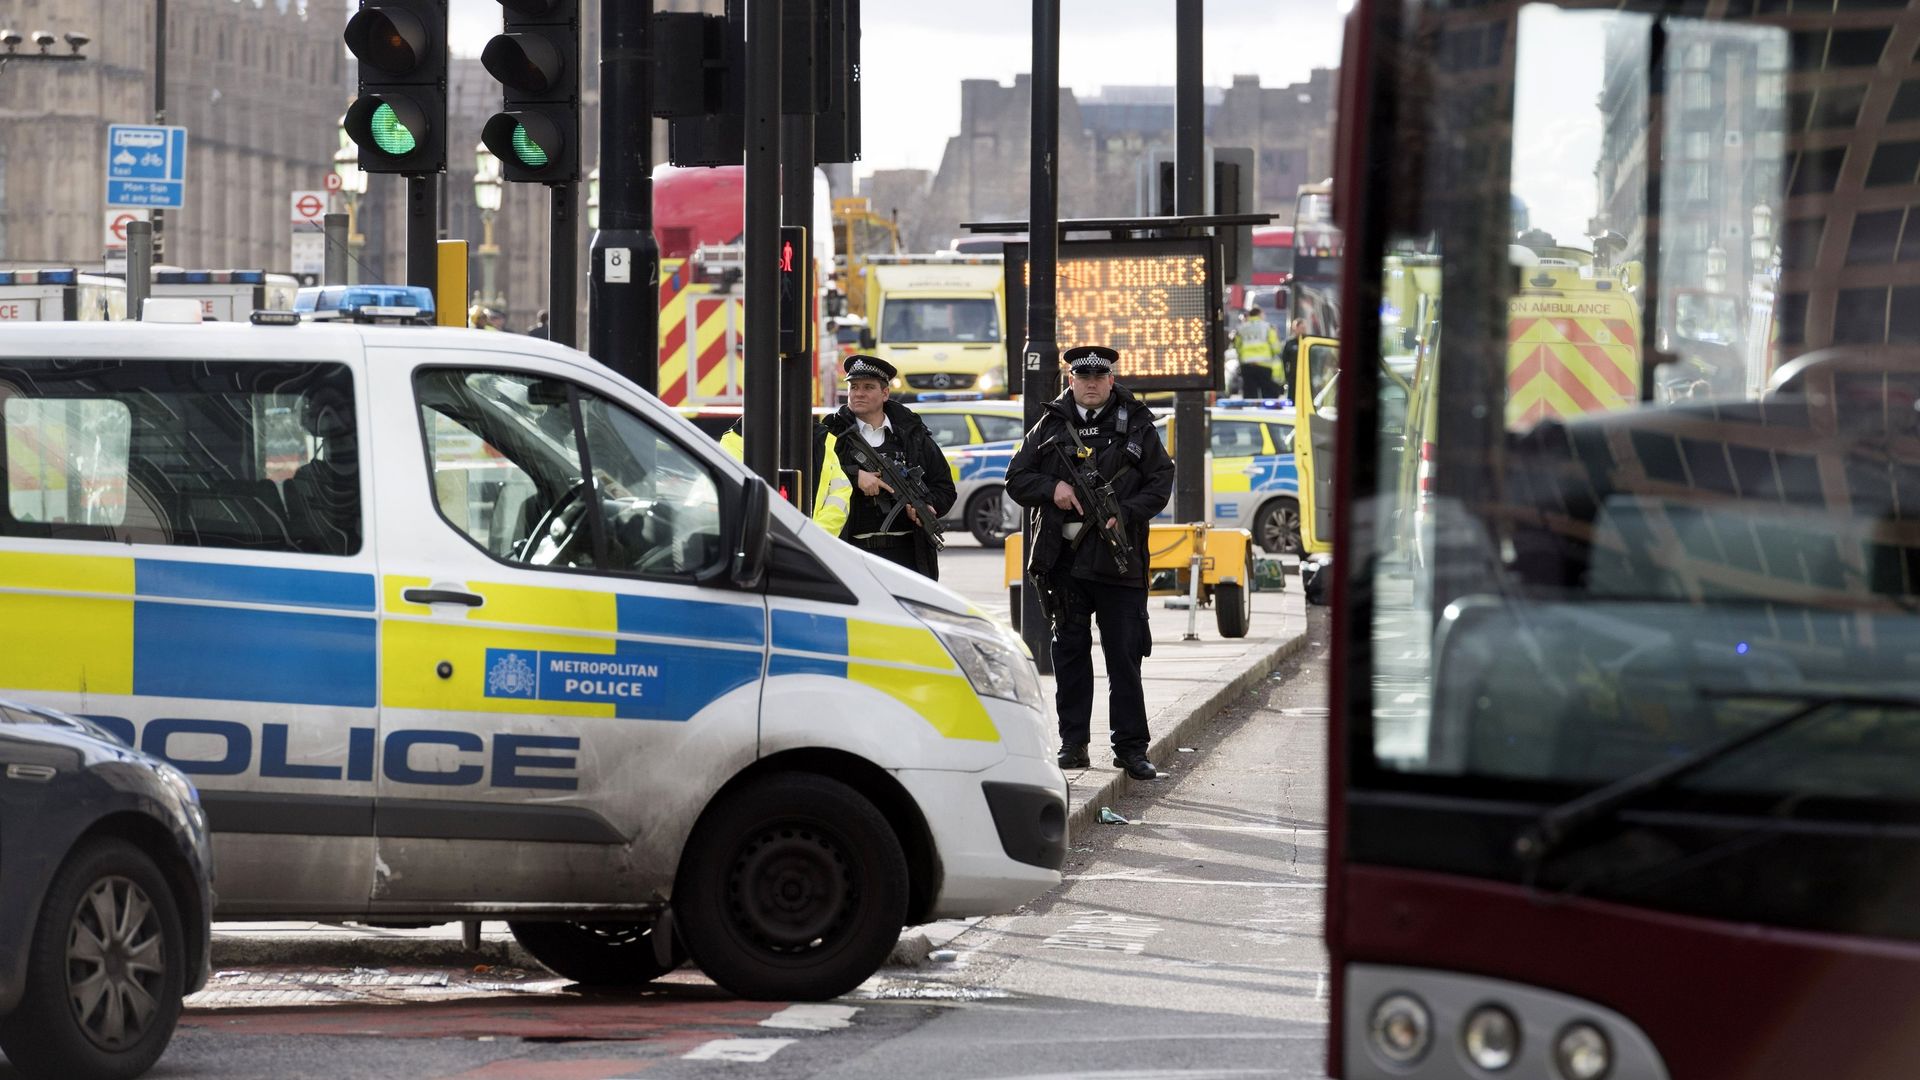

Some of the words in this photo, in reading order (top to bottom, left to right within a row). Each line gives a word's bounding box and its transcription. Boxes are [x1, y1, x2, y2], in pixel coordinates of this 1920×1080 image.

[328, 174, 341, 190] D
[1110, 257, 1206, 289] BRIDGES
[1058, 289, 1169, 318] WORKS
[1532, 303, 1612, 314] AMBULANCE
[1029, 354, 1038, 368] 7
[1119, 347, 1208, 376] DELAYS
[1079, 426, 1100, 437] POLICE
[550, 659, 658, 677] METROPOLITAN
[565, 679, 643, 697] POLICE
[76, 714, 580, 791] OLICE
